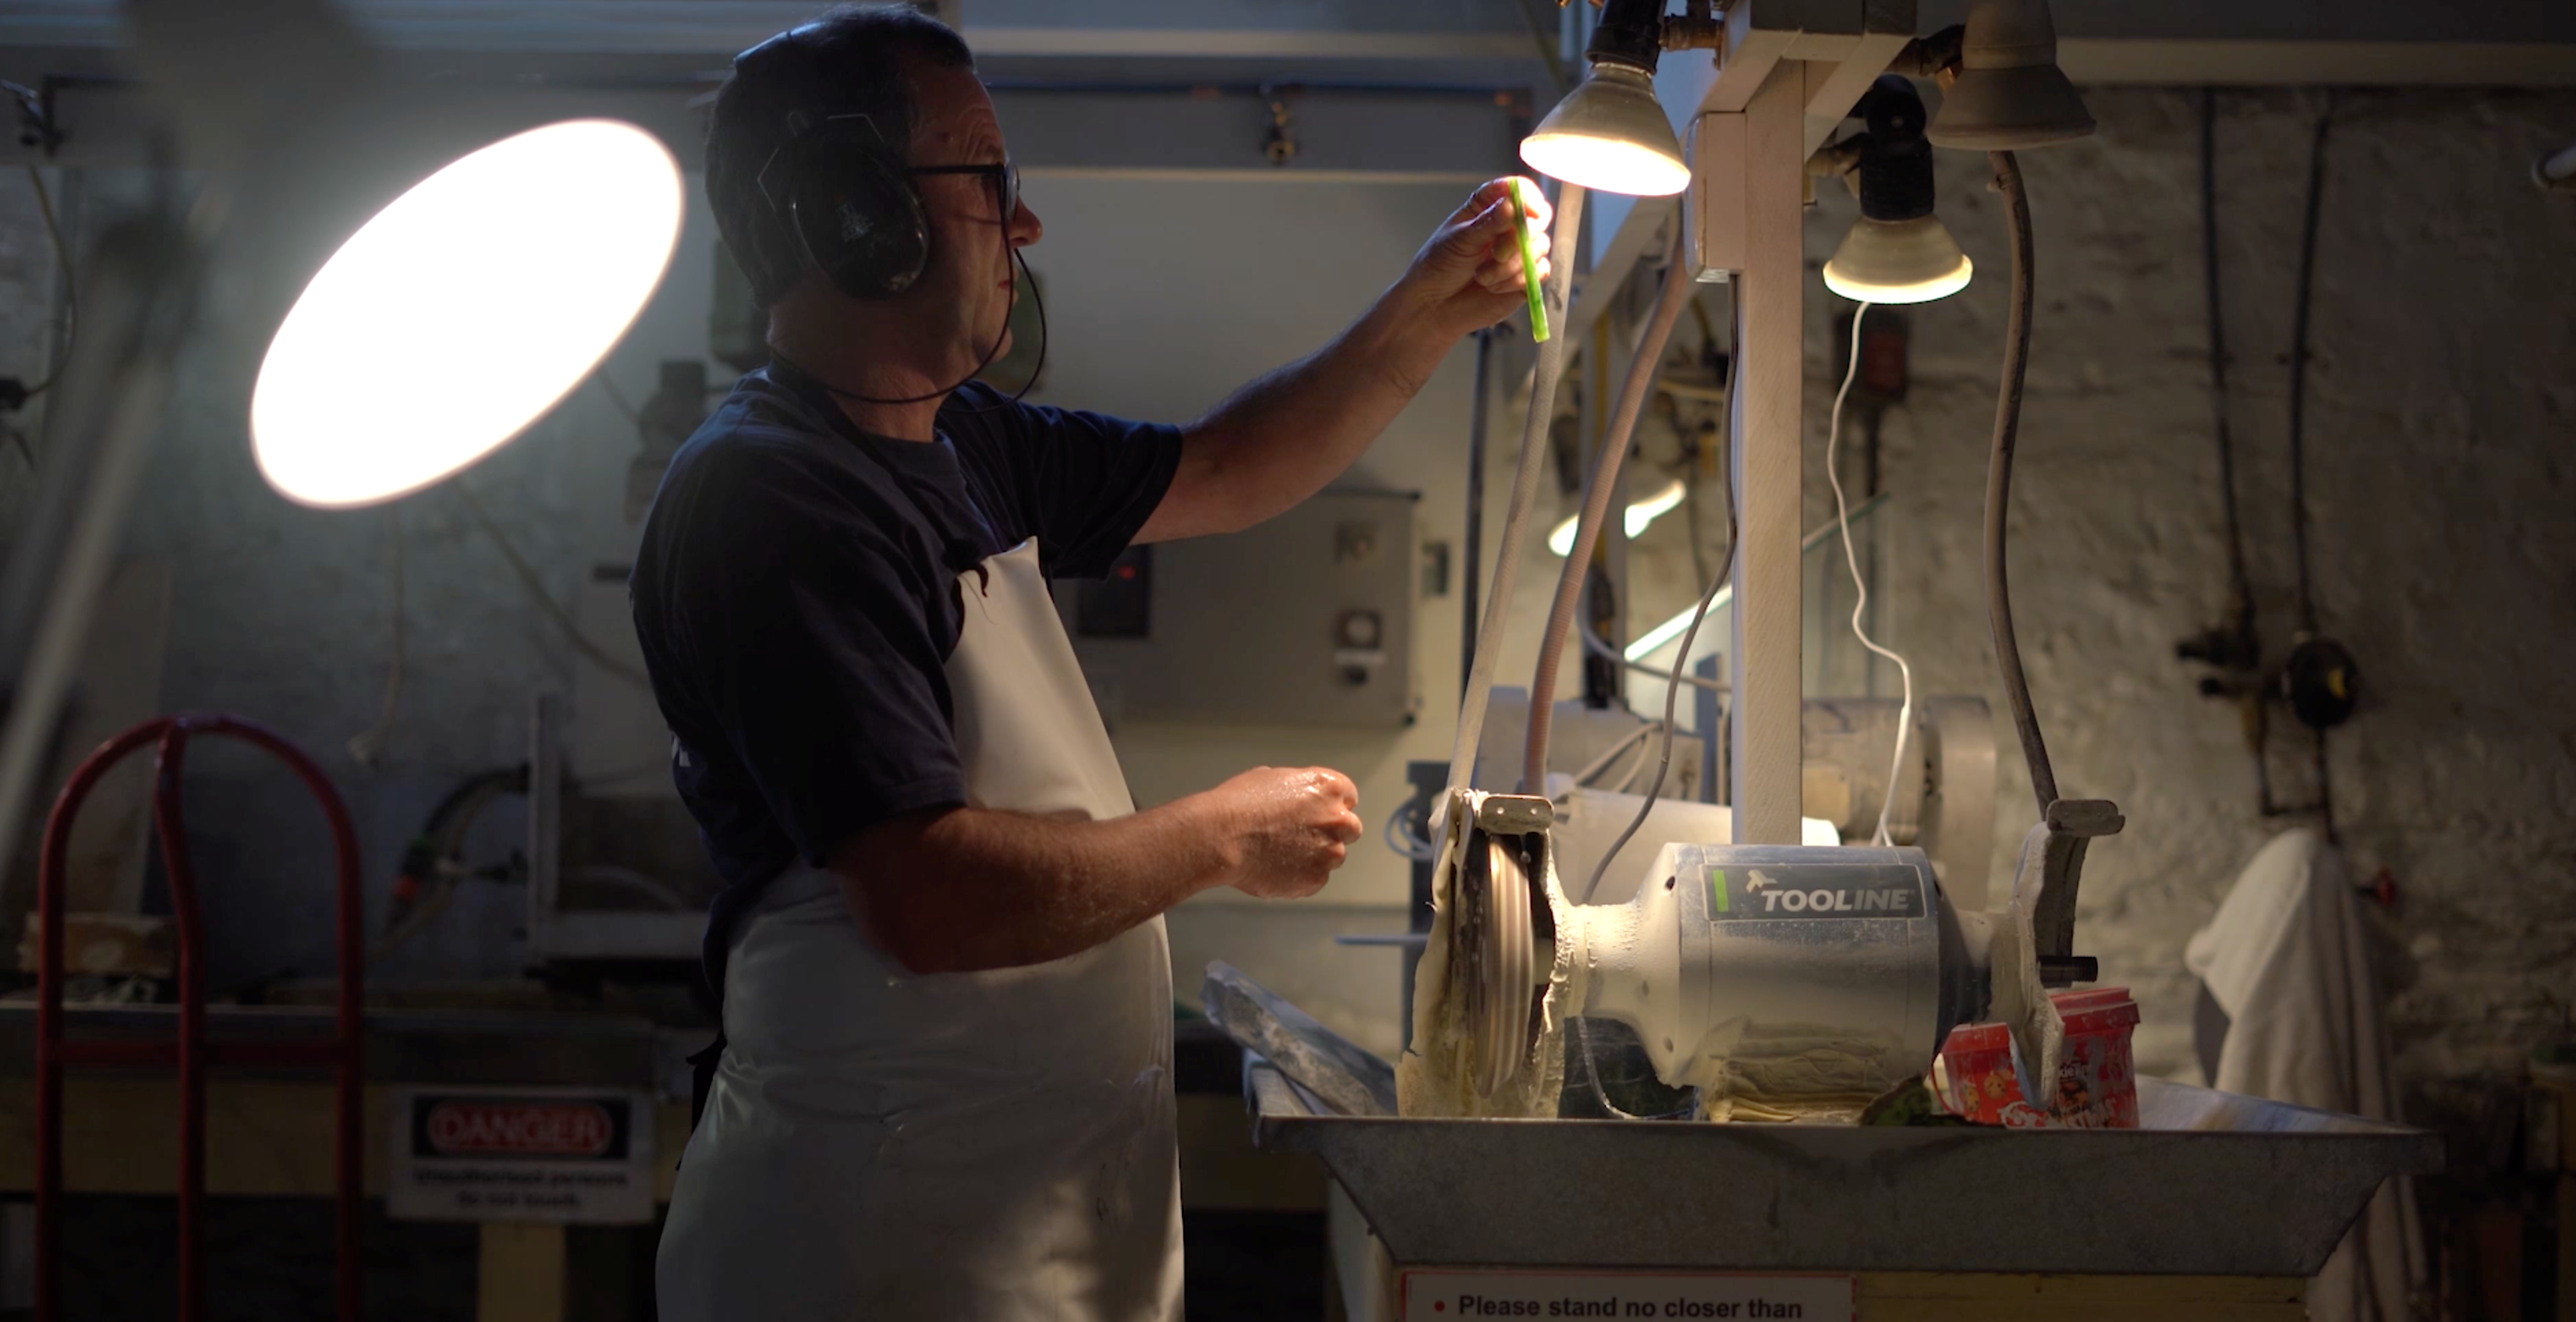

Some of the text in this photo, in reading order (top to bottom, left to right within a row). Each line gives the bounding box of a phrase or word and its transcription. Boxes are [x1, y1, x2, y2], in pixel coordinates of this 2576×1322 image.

[1760, 889, 1910, 912] TOOLINE
[437, 1111, 600, 1144] DANGER
[1459, 1295, 1802, 1318] Please stand no closer than
